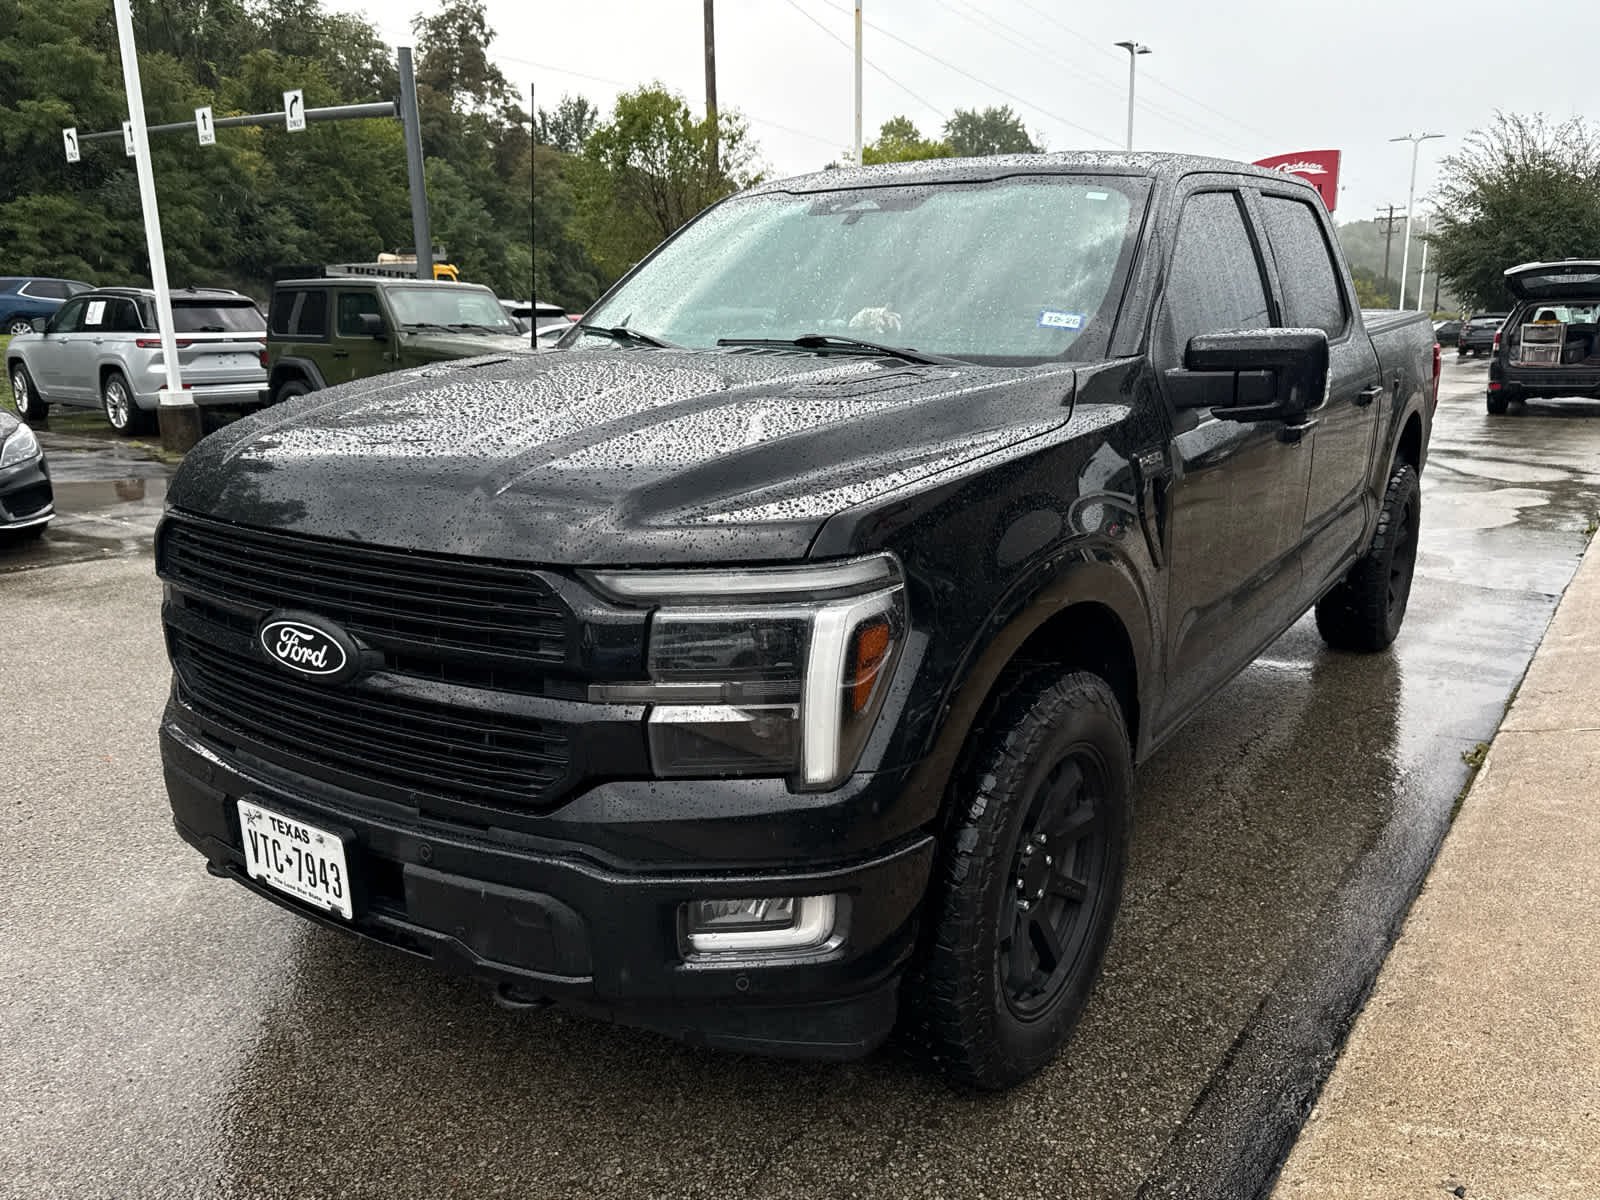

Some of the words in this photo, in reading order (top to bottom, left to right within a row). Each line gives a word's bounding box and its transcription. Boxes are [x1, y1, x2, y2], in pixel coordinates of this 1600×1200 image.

[289, 119, 303, 128] ONLY
[346, 265, 418, 279] TUCKER'S
[277, 627, 328, 668] Ford
[269, 816, 310, 844] TEXAS
